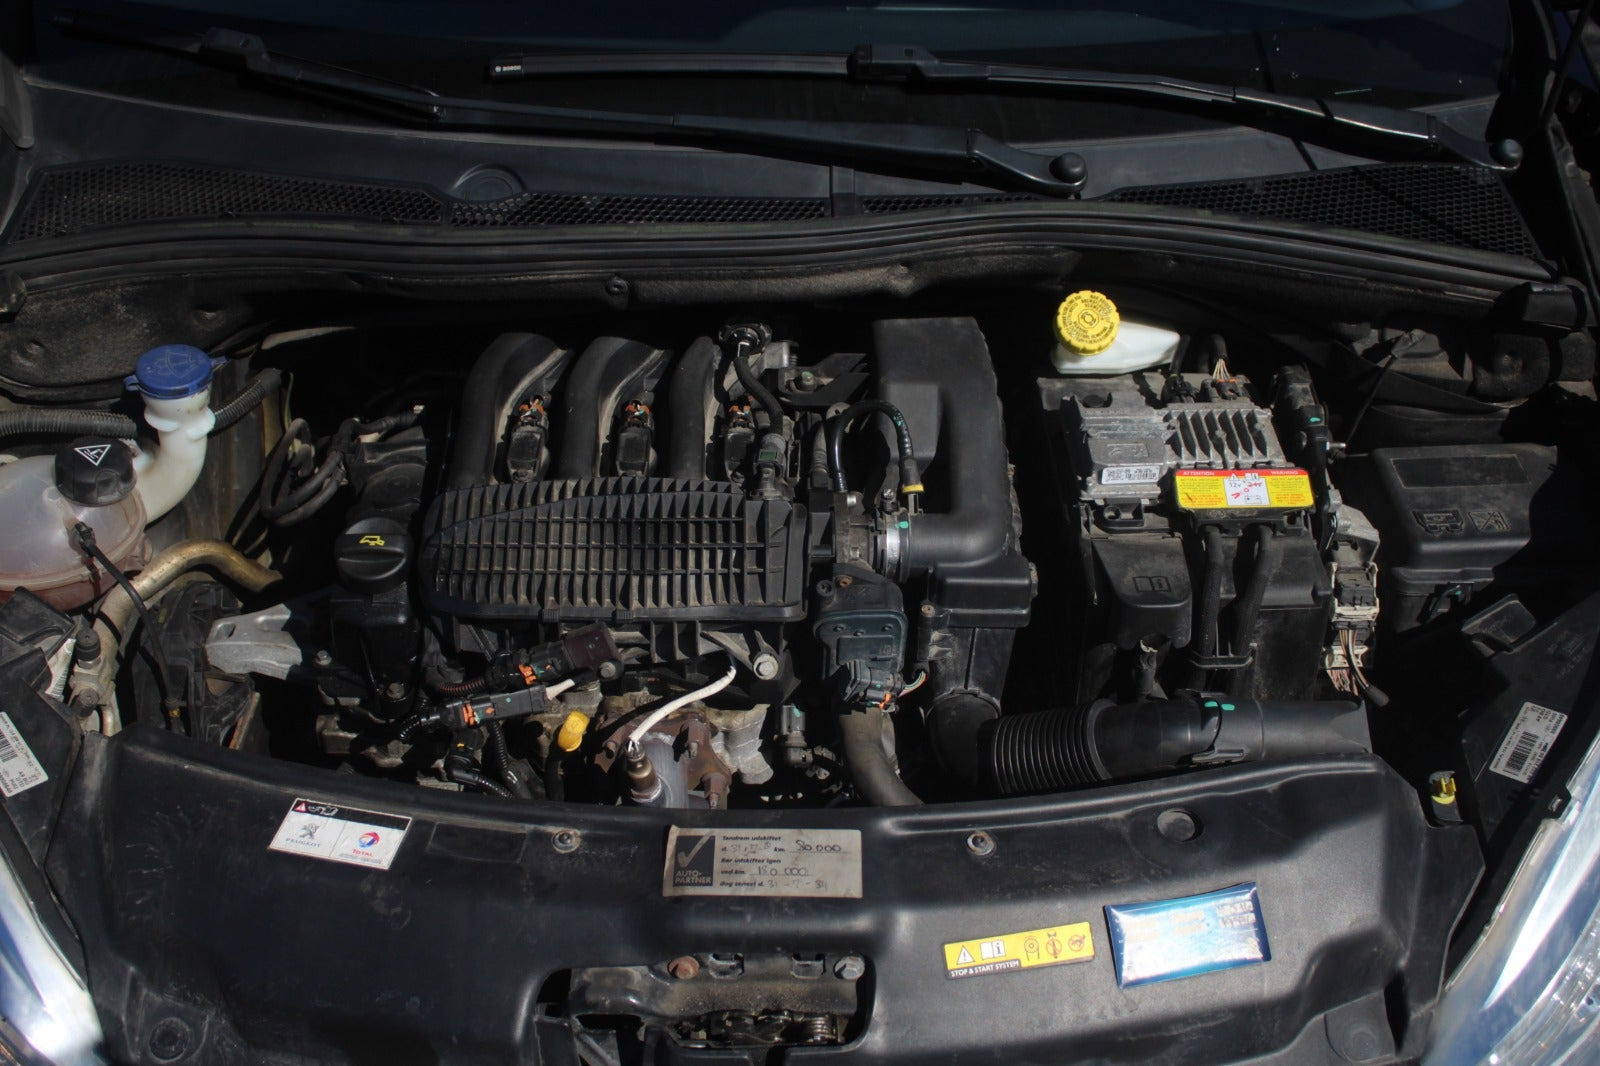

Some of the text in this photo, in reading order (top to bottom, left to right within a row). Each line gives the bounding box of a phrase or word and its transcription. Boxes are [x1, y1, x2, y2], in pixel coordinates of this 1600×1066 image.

[352, 848, 373, 857] TOTAL
[675, 869, 703, 877] AUTO-
[674, 876, 713, 885] PARTNER
[950, 968, 968, 978] STOP
[974, 963, 994, 974] START
[994, 959, 1019, 970] SYSTEM
